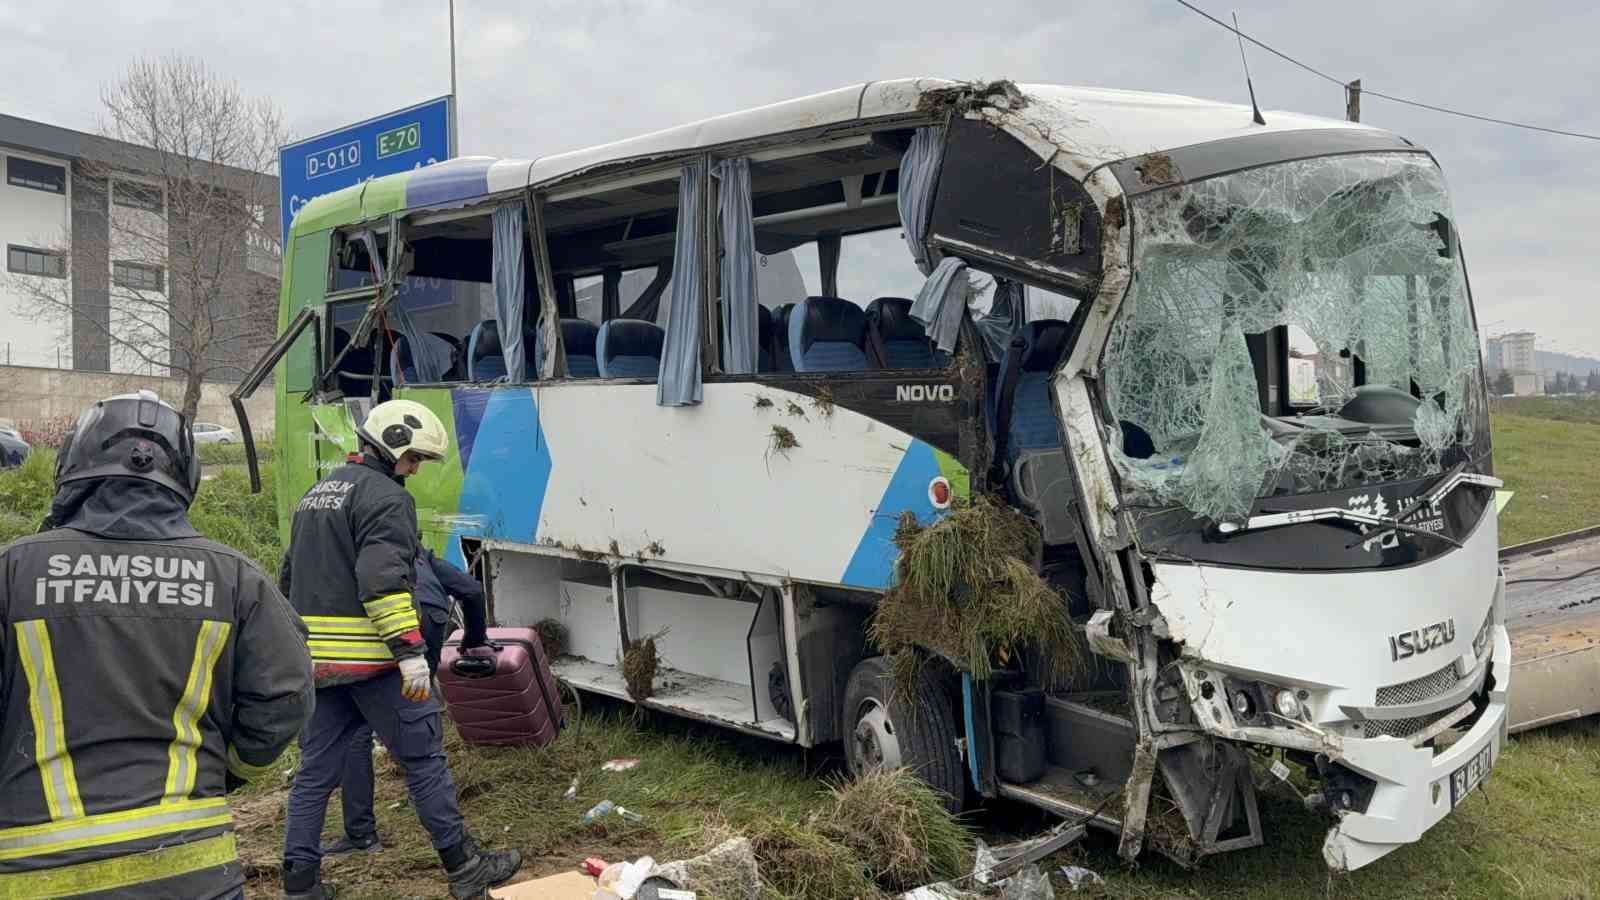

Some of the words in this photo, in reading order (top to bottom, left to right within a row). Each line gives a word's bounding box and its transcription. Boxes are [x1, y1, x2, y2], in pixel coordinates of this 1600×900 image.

[379, 127, 417, 155] E-70
[308, 146, 358, 175] D-010
[896, 385, 954, 402] NOVO
[47, 554, 205, 581] SAMSUN
[35, 577, 215, 608] İTFAİYESİ
[1388, 617, 1455, 662] ISUZU
